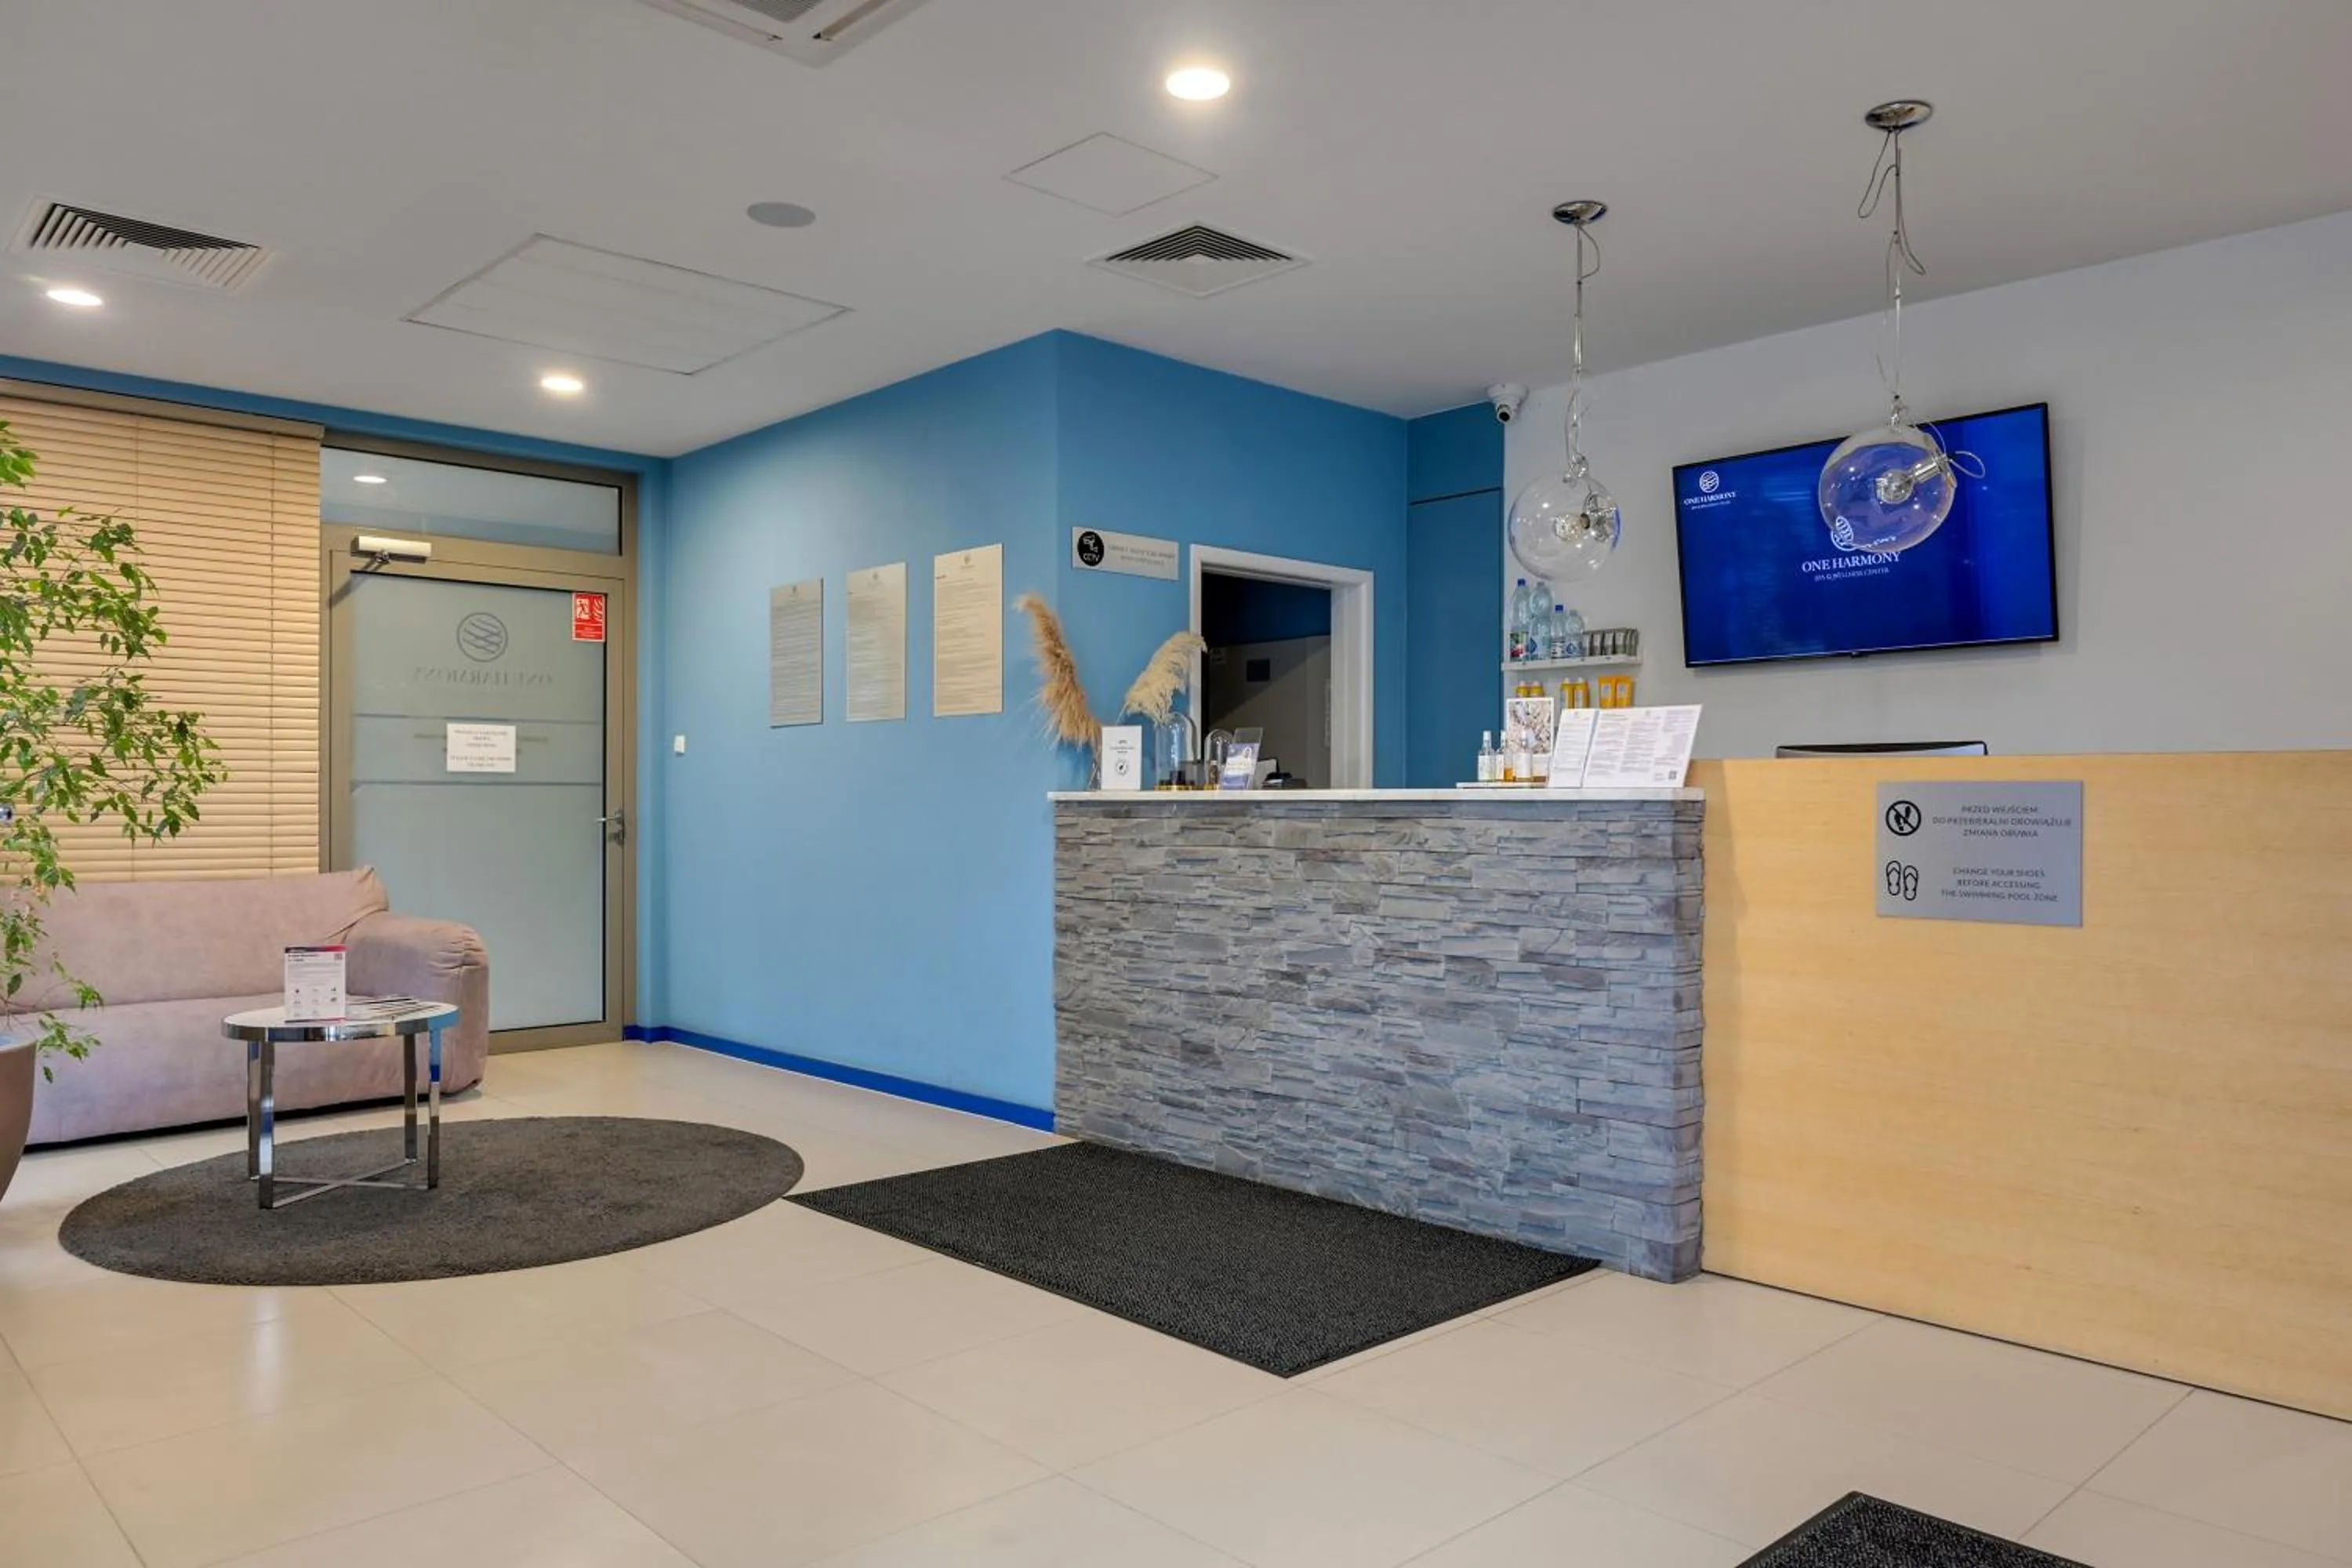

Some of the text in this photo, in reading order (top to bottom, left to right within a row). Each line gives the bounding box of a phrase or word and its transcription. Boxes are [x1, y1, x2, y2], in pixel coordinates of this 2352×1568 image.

[1684, 496, 1700, 506] ONE
[1802, 551, 1901, 573] ONE HARMONY
[1864, 567, 1890, 576] CENTER
[1961, 805, 1990, 814] PRZED
[1933, 816, 1946, 825] DO
[1963, 829, 2038, 838] ZMIANA OBUWIA
[1953, 867, 2045, 878] CHANGE YOUR SHOES
[1958, 878, 2042, 889] BEFORE ACCESSING
[1940, 889, 2059, 902] THE SWIMMING POOL ZONE
